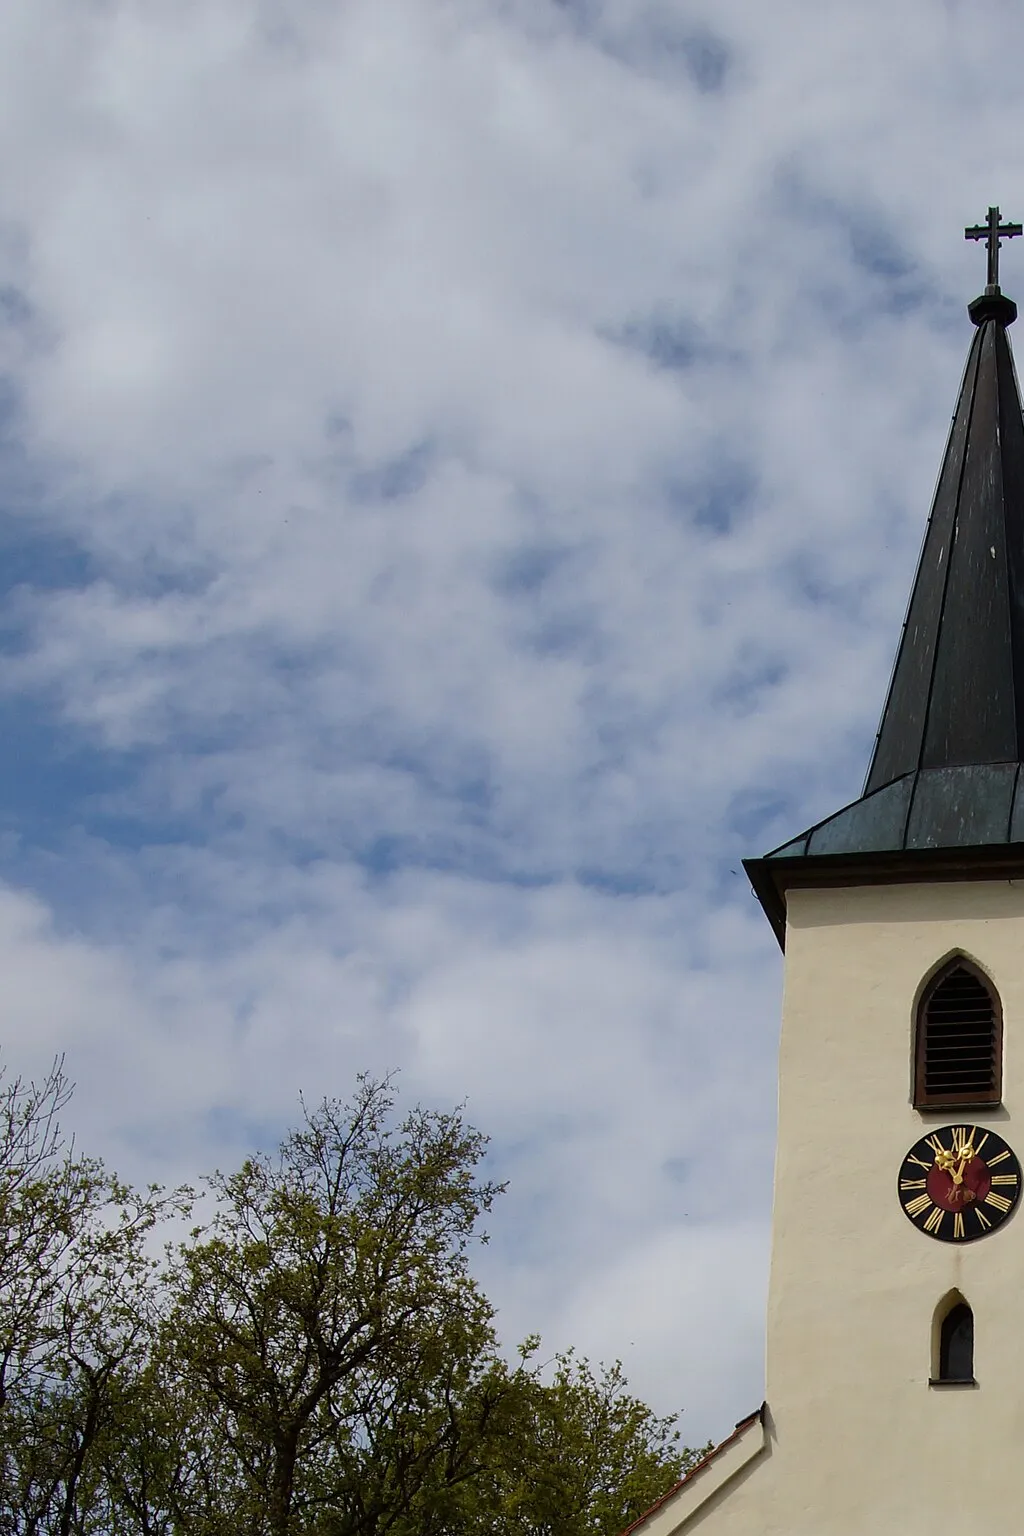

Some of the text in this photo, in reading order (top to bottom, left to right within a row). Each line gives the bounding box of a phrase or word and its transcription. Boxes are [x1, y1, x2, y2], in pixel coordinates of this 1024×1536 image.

[951, 1127, 967, 1152] XII
[906, 1153, 933, 1172] X
[986, 1150, 1011, 1168] II
[991, 1174, 1018, 1186] III
[923, 1207, 945, 1234] VII
[953, 1212, 965, 1238] VI
[974, 1207, 992, 1230] V
